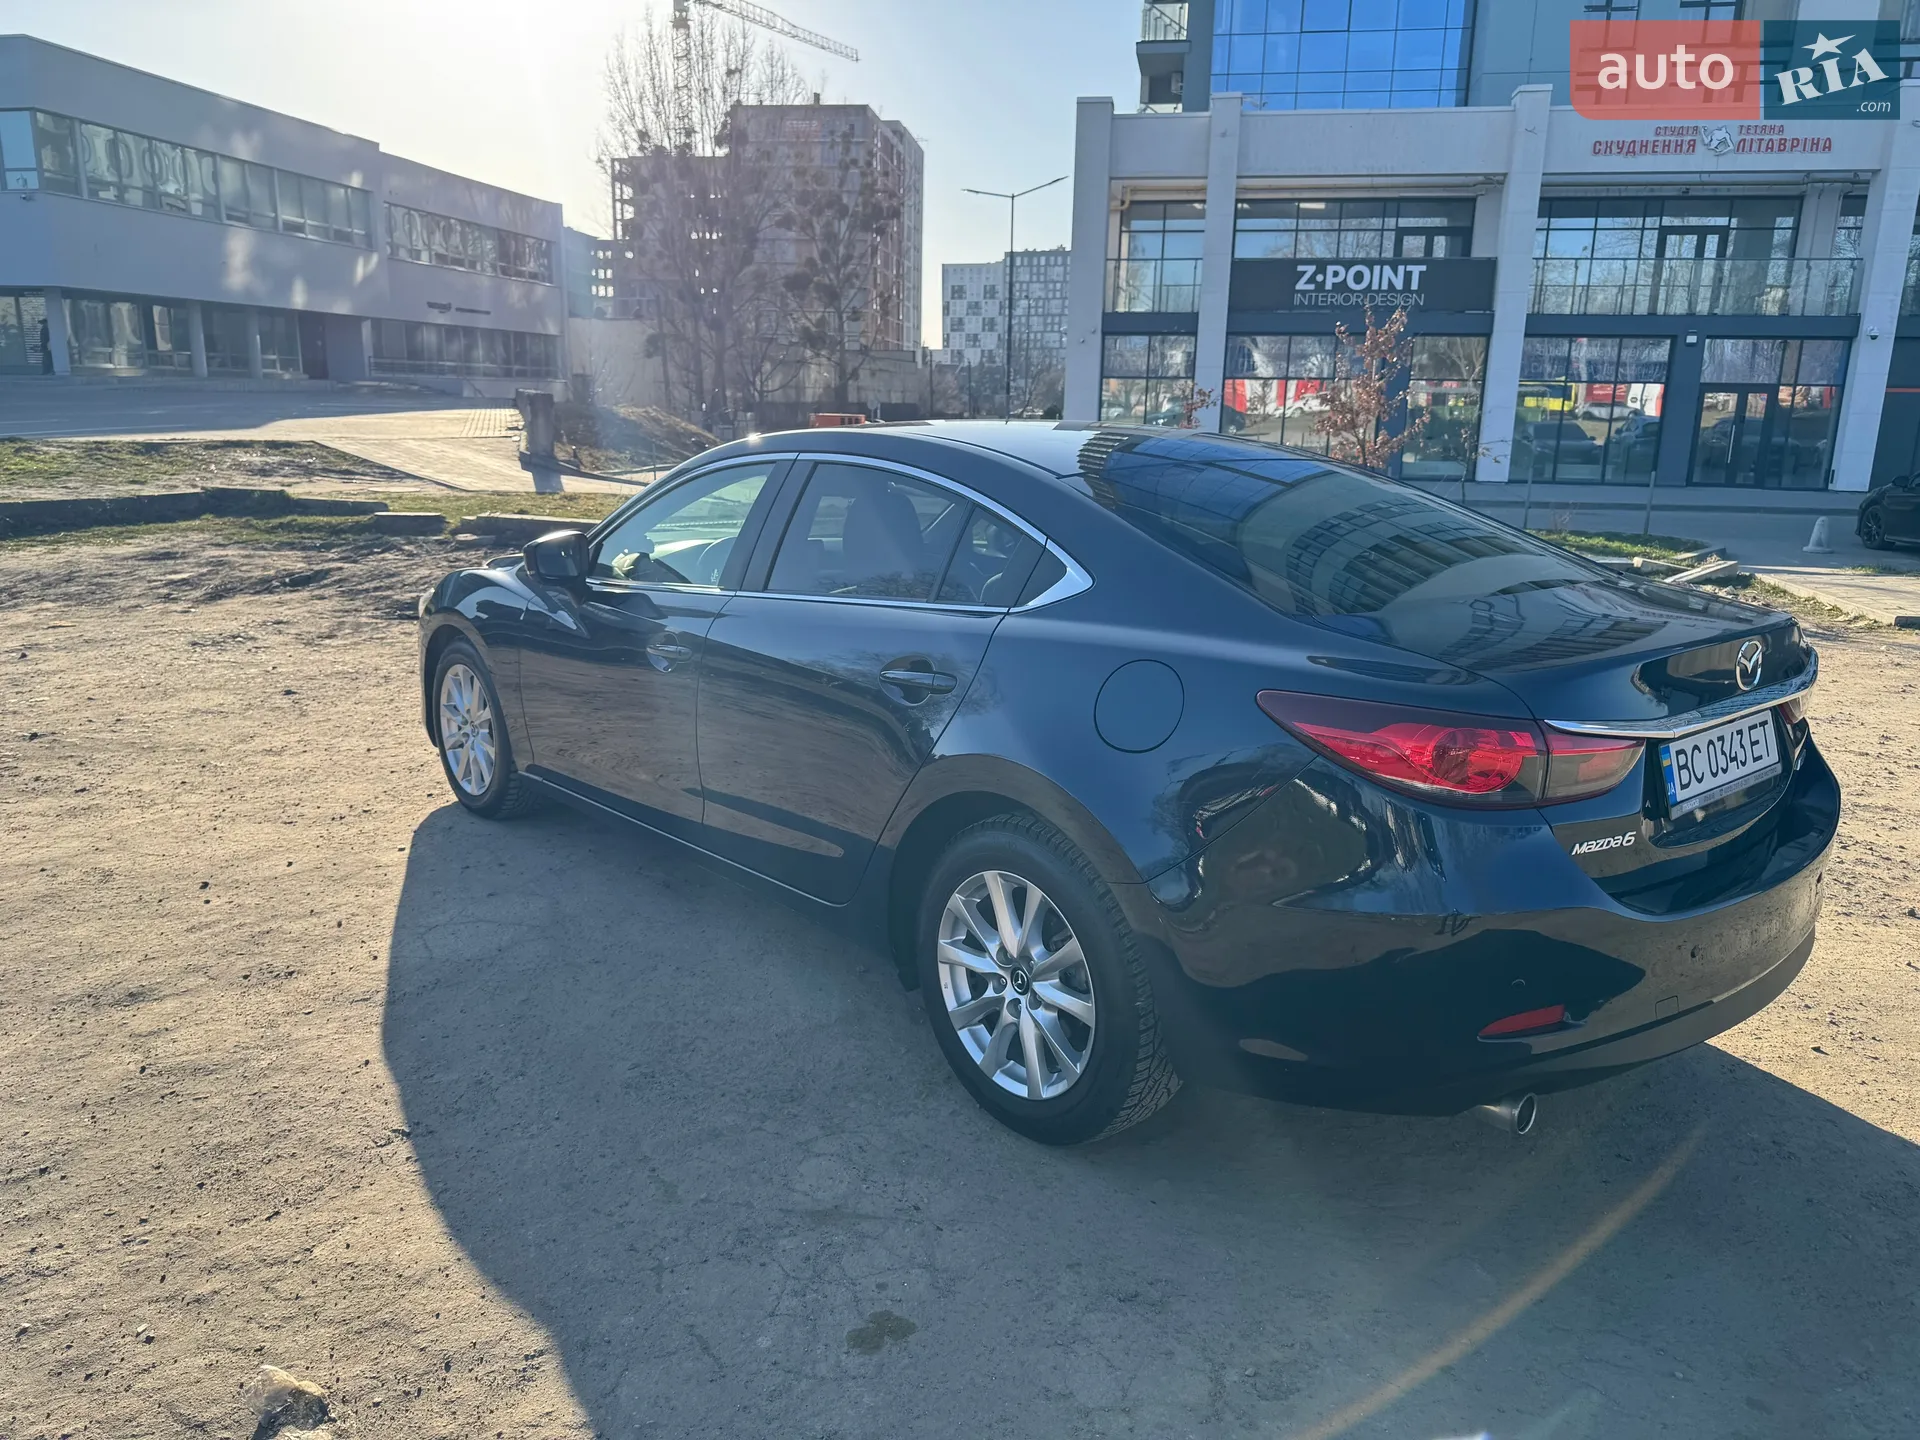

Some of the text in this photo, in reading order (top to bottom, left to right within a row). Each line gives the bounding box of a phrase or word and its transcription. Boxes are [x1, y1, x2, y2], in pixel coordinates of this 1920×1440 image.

[1655, 125, 1699, 136] СТУДІЯ
[1738, 124, 1785, 135] ТЕТЯНА
[1592, 139, 1697, 156] СХУДНЕННЯ
[1735, 137, 1833, 153] ЛІТАВРІНА
[1293, 293, 1425, 306] INTERIOR DESIGN
[1675, 744, 1705, 791] BC
[1706, 728, 1747, 778] 0343
[1748, 719, 1770, 763] ET
